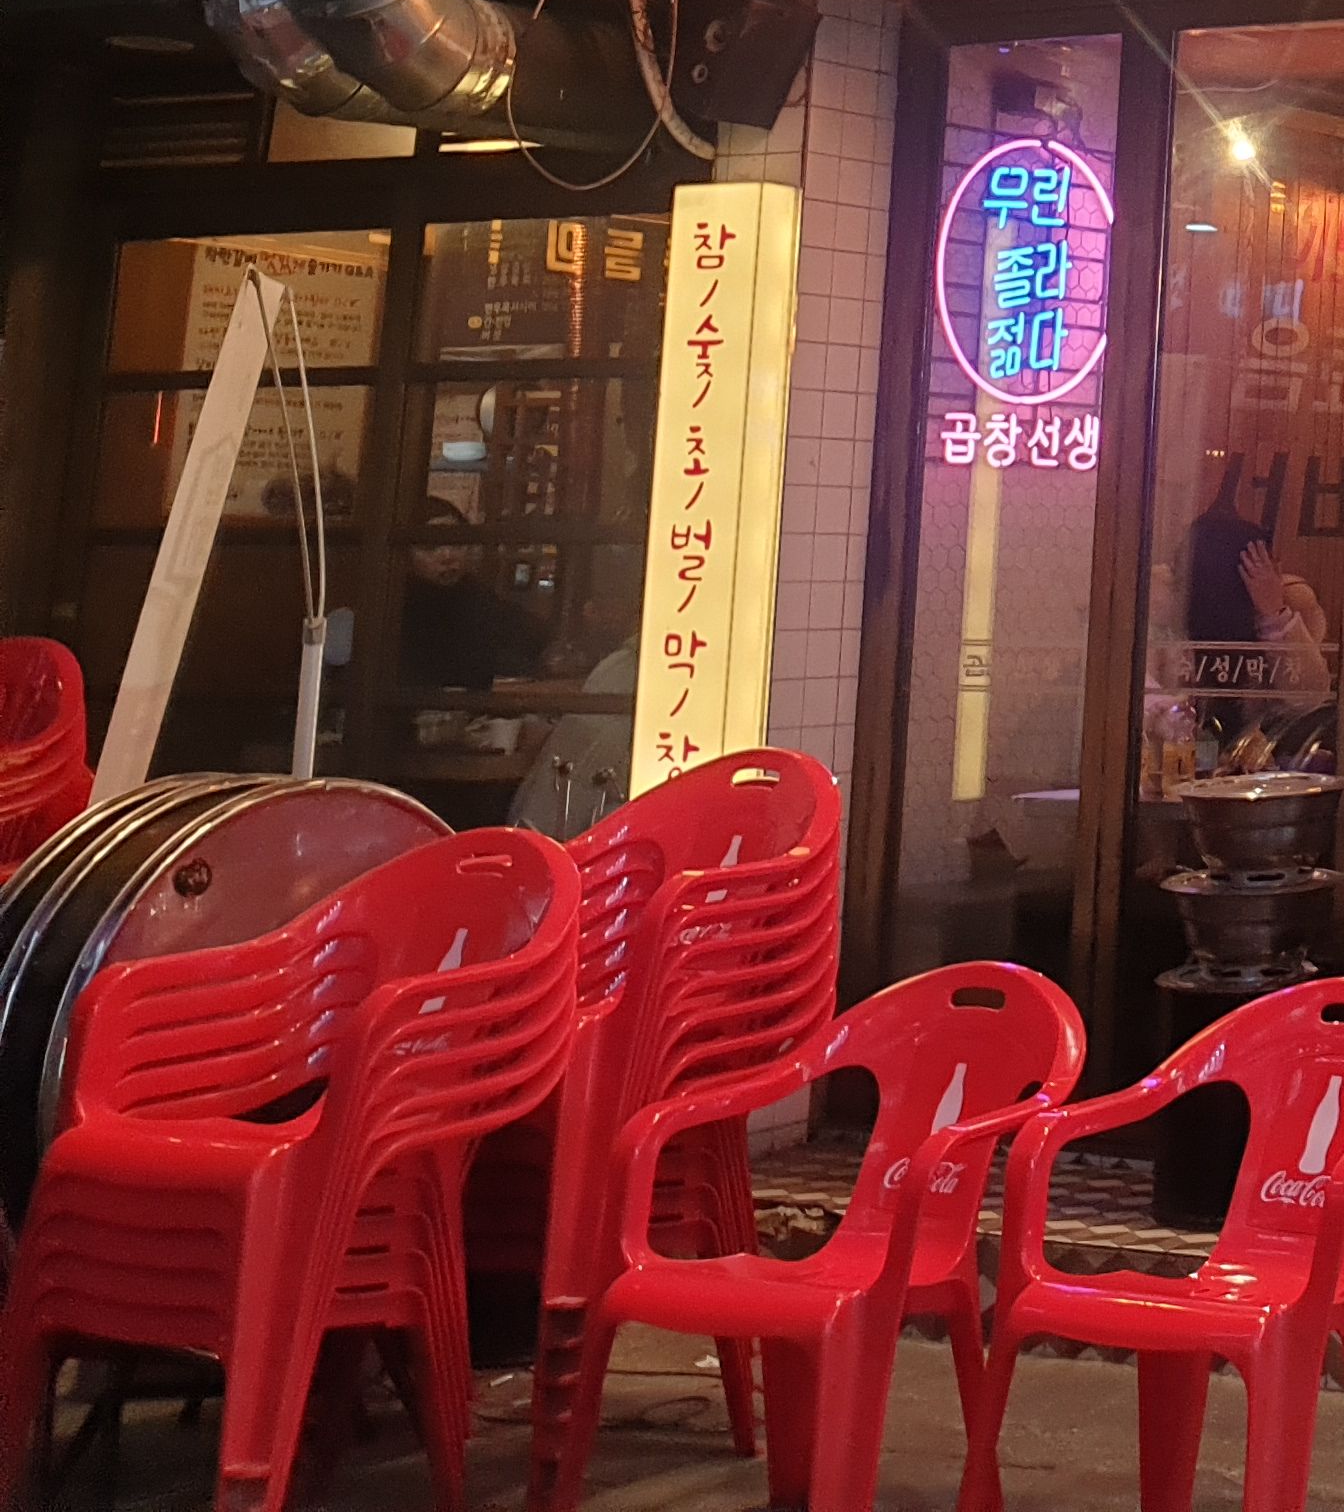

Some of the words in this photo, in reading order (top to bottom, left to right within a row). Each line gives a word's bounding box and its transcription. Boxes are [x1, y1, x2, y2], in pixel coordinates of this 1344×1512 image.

[993, 240, 1073, 310] 졸라
[987, 308, 1068, 379] 젊다
[940, 411, 1100, 471] 곱창선생
